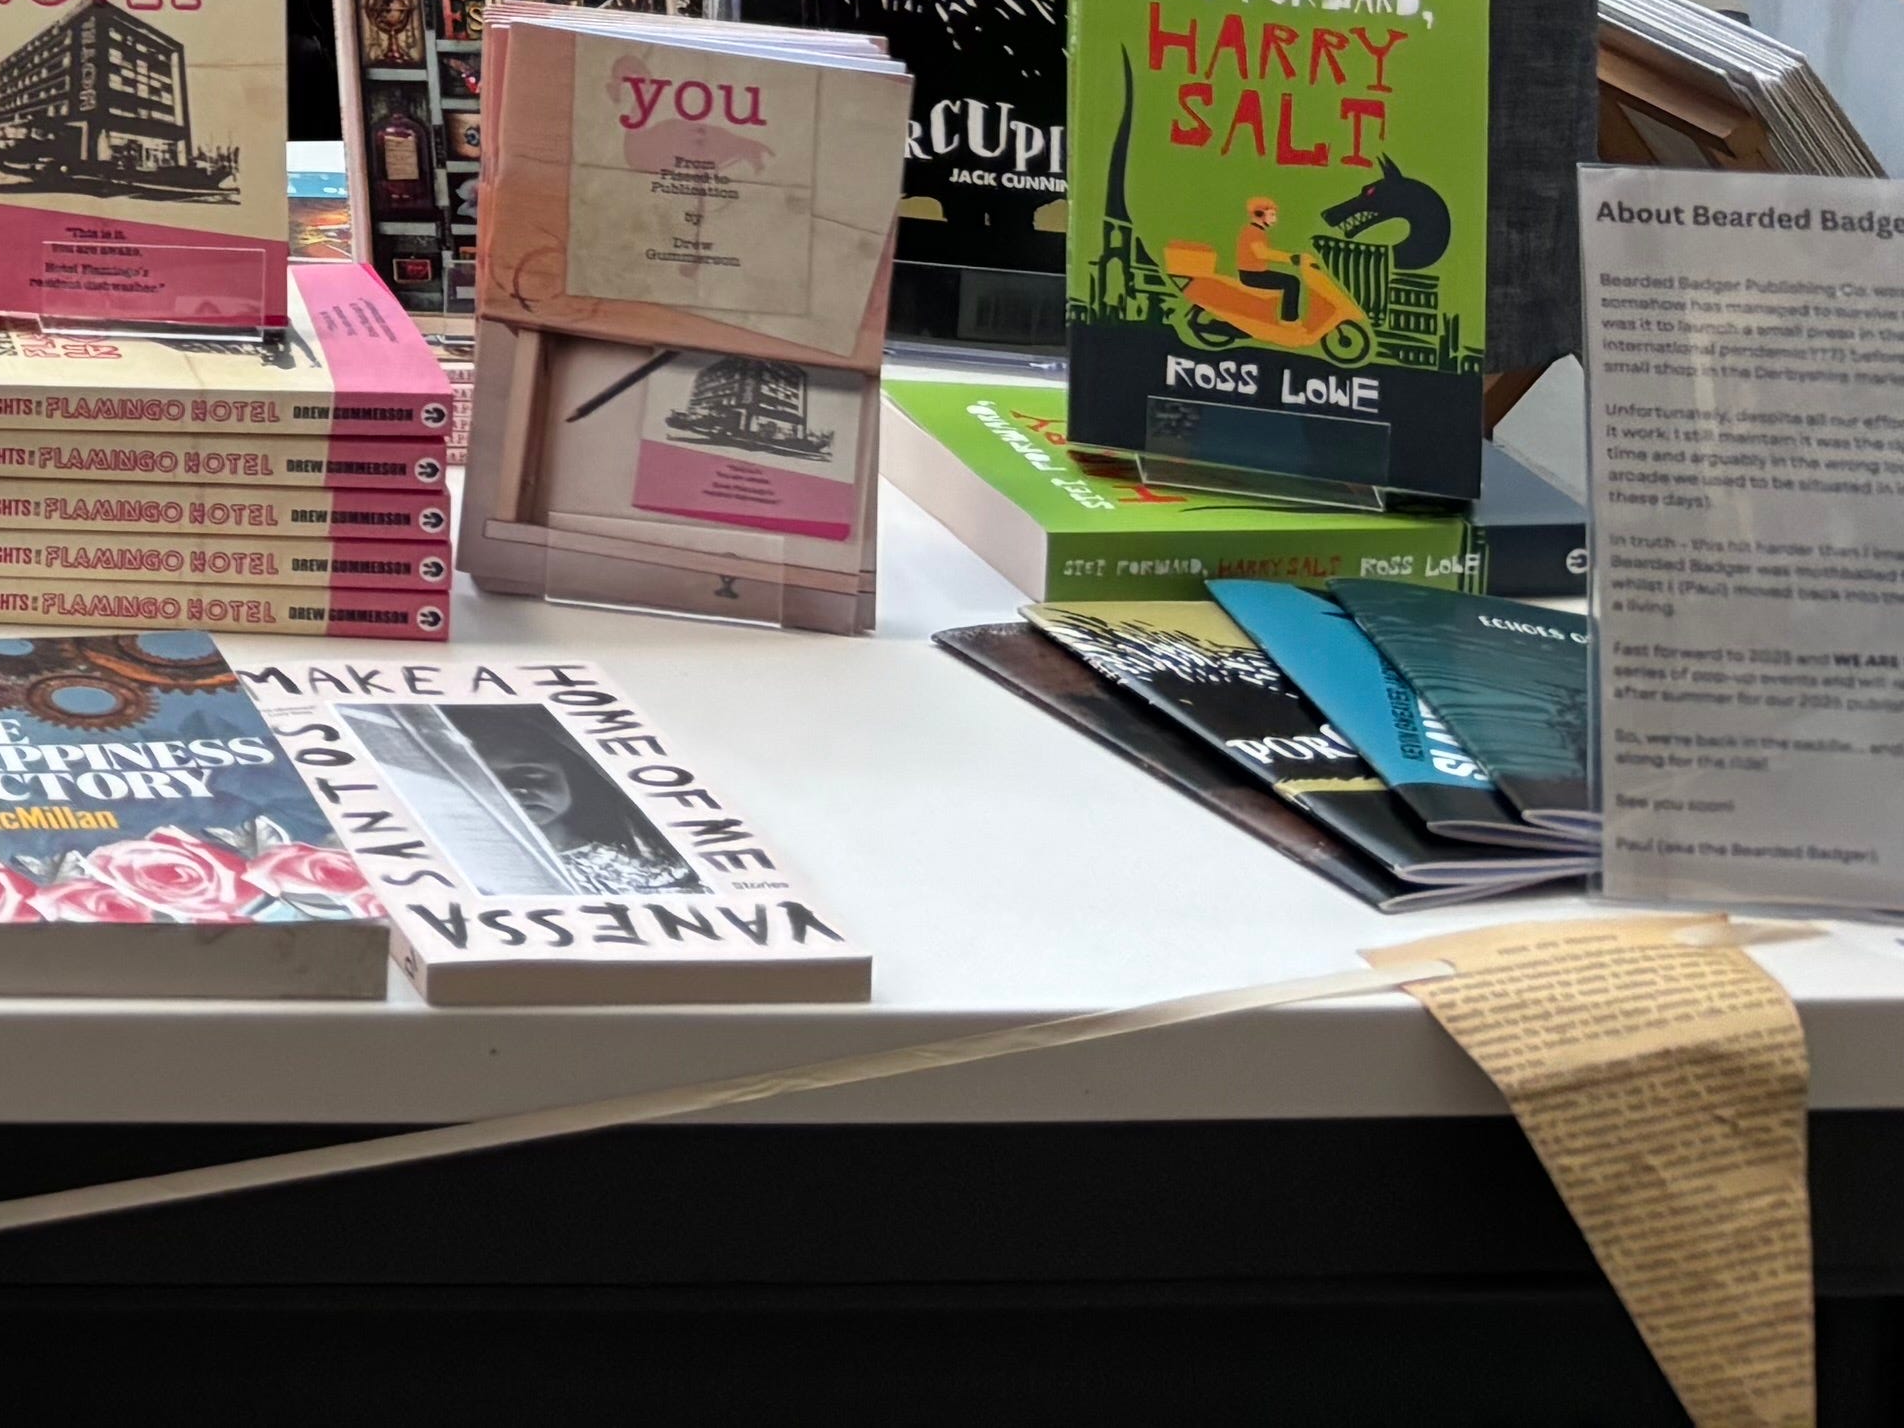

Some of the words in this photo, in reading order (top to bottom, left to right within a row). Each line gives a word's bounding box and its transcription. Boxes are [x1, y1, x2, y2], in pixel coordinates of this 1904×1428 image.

[1149, 1, 1408, 94] HARRY
[619, 75, 767, 130] you
[1170, 82, 1386, 166] SALT
[1597, 201, 1684, 225] About
[1693, 205, 1811, 230] Bearded
[1821, 210, 1904, 239] Badge
[45, 397, 185, 421] FLAMINGO
[192, 400, 280, 422] HOTEL
[293, 406, 329, 420] DREW
[333, 404, 414, 423] GUMMERSON
[1165, 356, 1259, 396] ROSS
[1281, 370, 1380, 414] LOWE
[234, 665, 441, 700] MAKE
[473, 666, 517, 696] A
[520, 665, 668, 757] HOME
[271, 723, 455, 888] SANTOS
[629, 764, 722, 812] OF
[667, 817, 776, 873] ME
[407, 901, 845, 949] VANESSA
